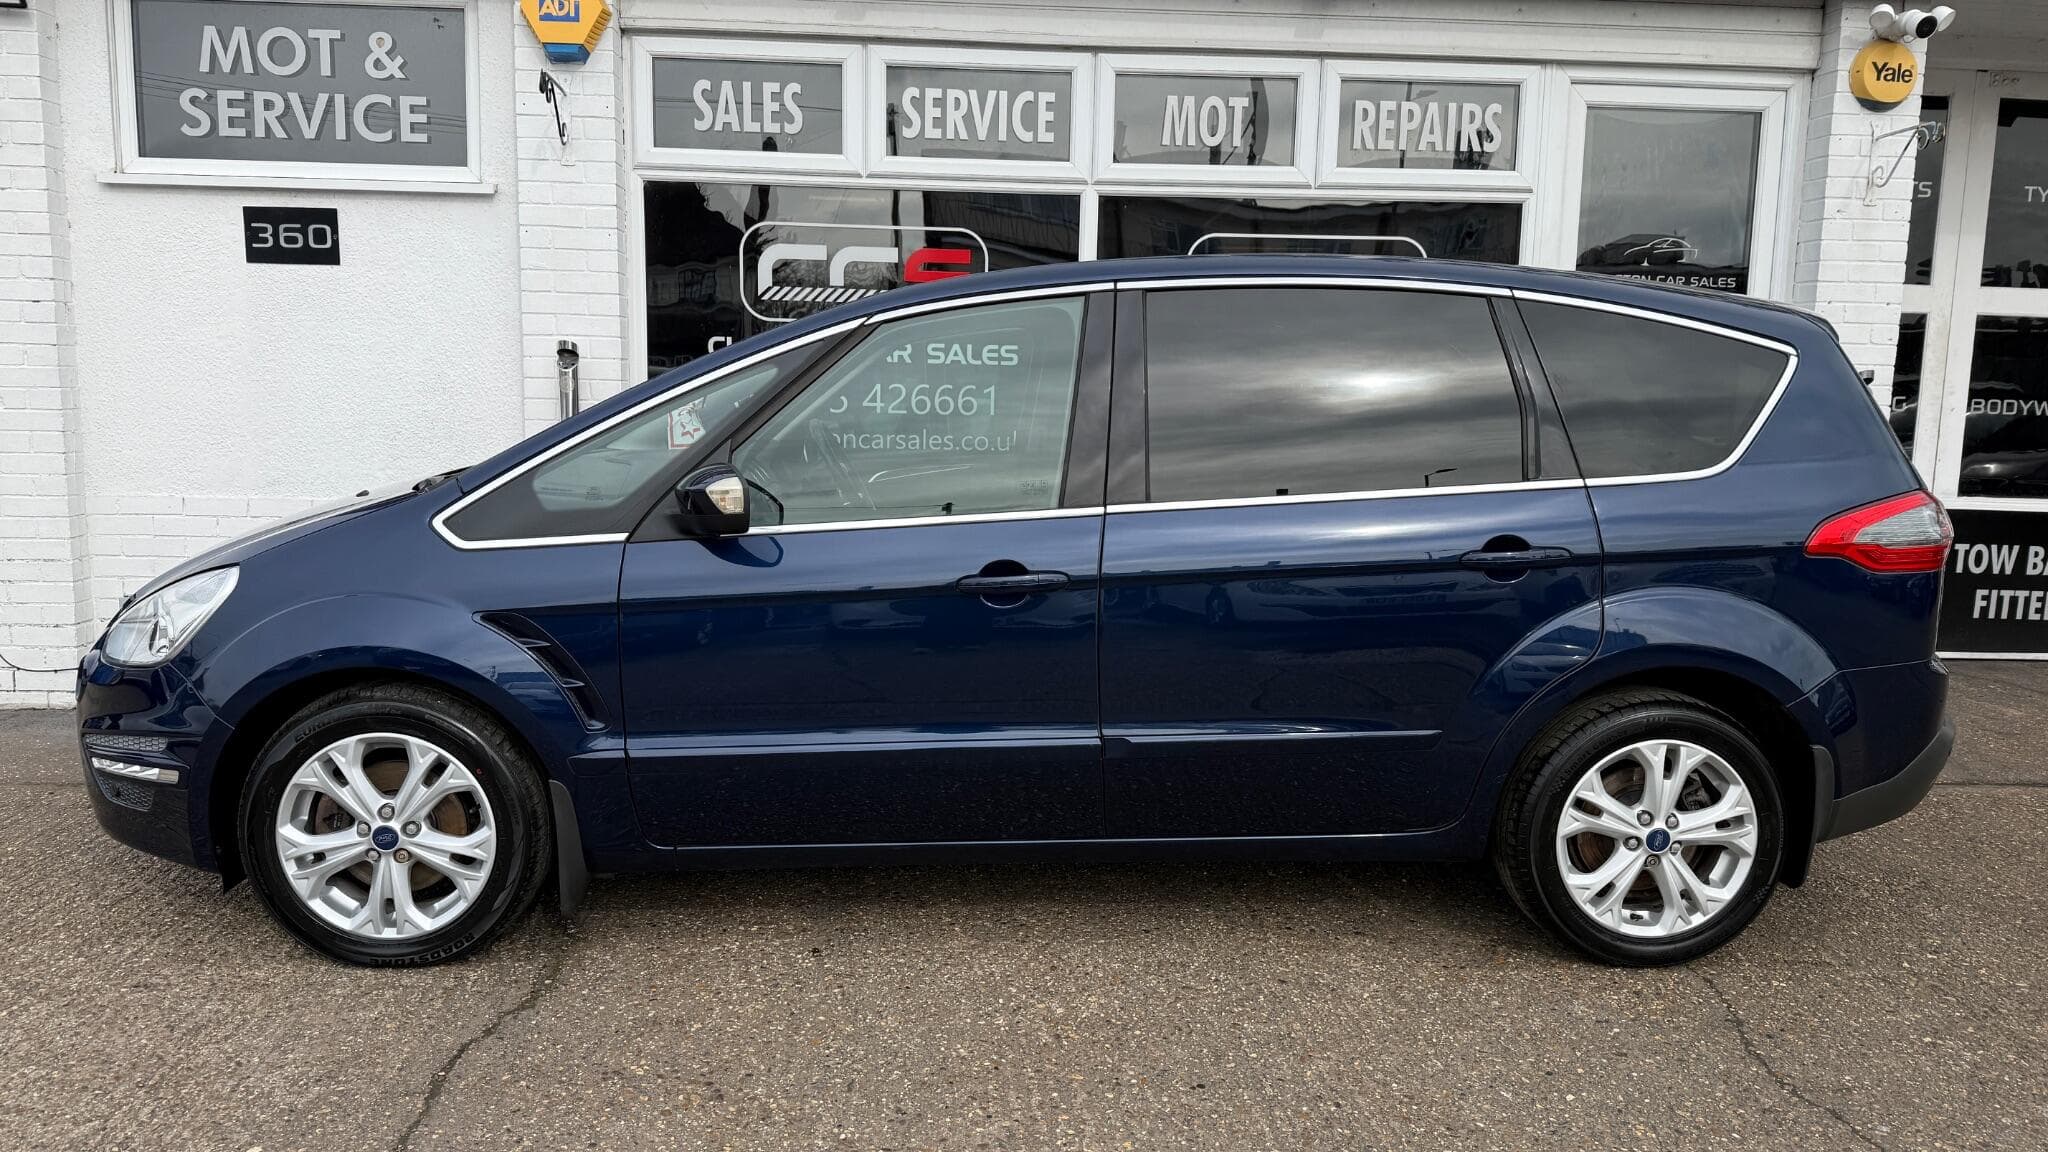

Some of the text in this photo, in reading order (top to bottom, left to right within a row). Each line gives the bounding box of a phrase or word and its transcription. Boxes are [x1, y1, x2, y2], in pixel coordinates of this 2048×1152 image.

[199, 25, 409, 80] MOT &
[1872, 61, 1913, 83] Yale
[179, 87, 432, 145] SERVICE
[692, 79, 803, 135] SALES
[901, 86, 1056, 144] SERVICE
[1161, 94, 1250, 149] MOT
[1351, 100, 1503, 154] REPAIRS
[250, 222, 333, 249] 360
[1690, 277, 1737, 288] SALES
[926, 343, 1019, 366] SALES
[862, 383, 996, 416] 426661
[1954, 543, 2048, 576] TOW B
